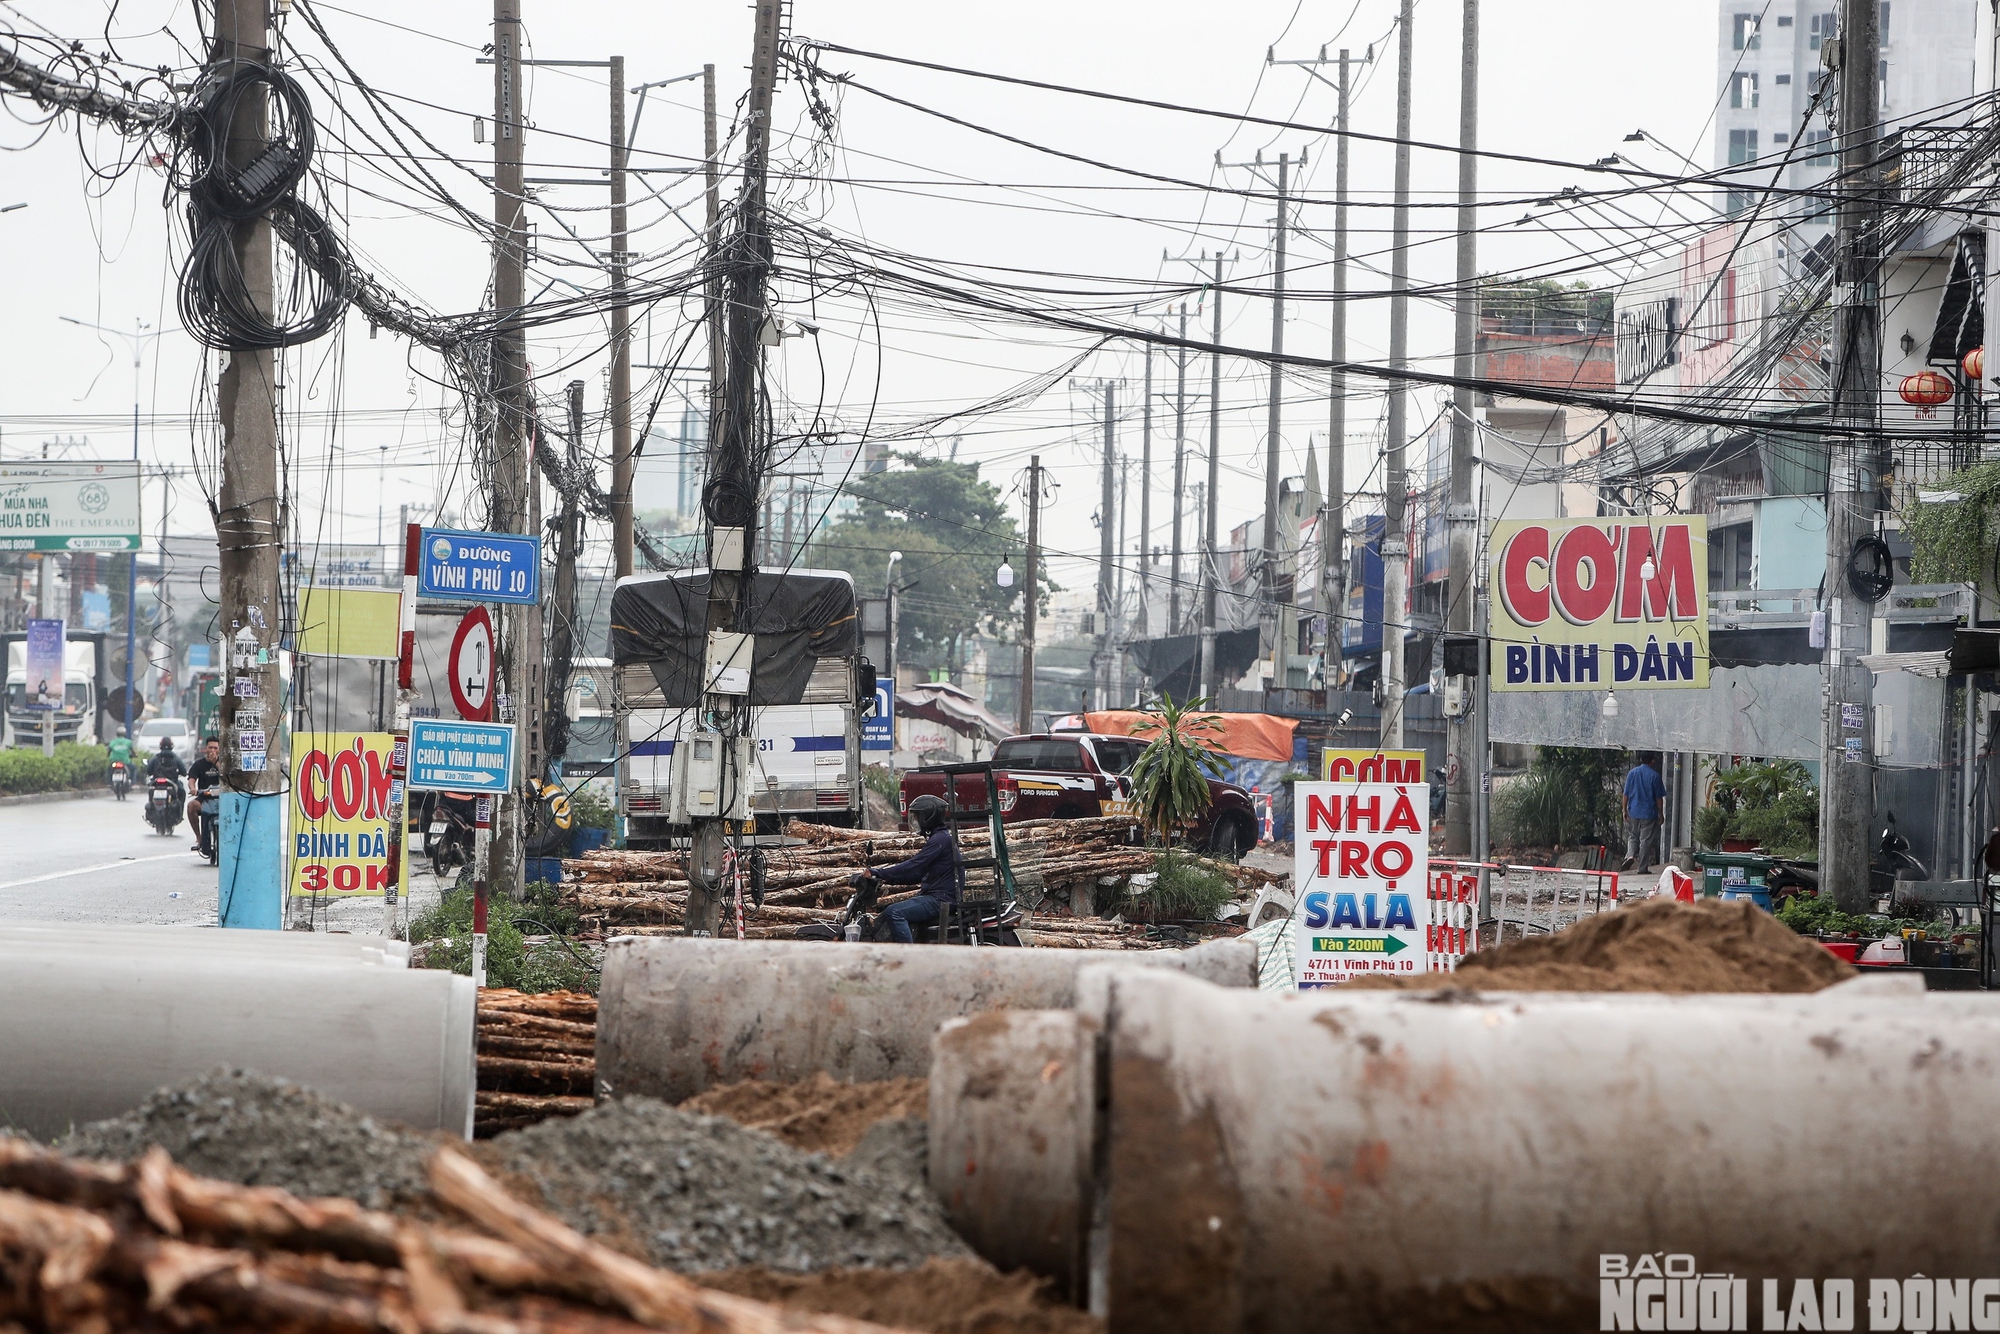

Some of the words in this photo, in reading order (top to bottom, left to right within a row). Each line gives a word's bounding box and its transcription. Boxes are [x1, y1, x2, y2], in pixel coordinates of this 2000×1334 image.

[86, 493, 101, 503] 68
[54, 519, 76, 527] THE
[80, 518, 135, 527] EMERALD
[459, 545, 511, 563] ĐƯỜNG
[348, 573, 377, 586] ĐÔNG
[432, 561, 466, 589] VĨNH
[472, 564, 501, 591] PHÚ
[509, 570, 526, 593] 10
[1498, 524, 1699, 627] CƠM
[1506, 635, 1599, 684] BÌNH
[1613, 634, 1694, 682] DÂN
[422, 729, 436, 741] GIÁO
[436, 730, 446, 744] HỘI
[446, 731, 461, 745] PHẬT
[461, 732, 475, 744] GIÁO
[476, 733, 488, 747] VIỆT
[488, 735, 502, 746] NAM
[759, 739, 774, 751] 31
[417, 746, 445, 766] CHÙA
[448, 748, 474, 768] VĨNH
[475, 752, 504, 769] MINH
[297, 736, 394, 822] CƠM
[444, 771, 456, 780] Vào
[457, 772, 475, 781] 700m
[1036, 789, 1059, 797] RANGER
[1306, 786, 1422, 834] NHÀ
[297, 827, 349, 858] BÌNH
[358, 827, 390, 858] DÂ
[1310, 840, 1413, 891] TRỌ
[300, 865, 389, 891] 30K
[1304, 890, 1417, 931] SALA
[1320, 938, 1344, 951] Vào
[1347, 939, 1384, 951] 200M
[1308, 959, 1339, 970] 47/11
[1344, 958, 1369, 970] Vĩnh
[1373, 959, 1395, 970] Phú
[1400, 960, 1413, 971] 10
[1303, 972, 1316, 980] TP.
[1318, 972, 1346, 983] Thuận
